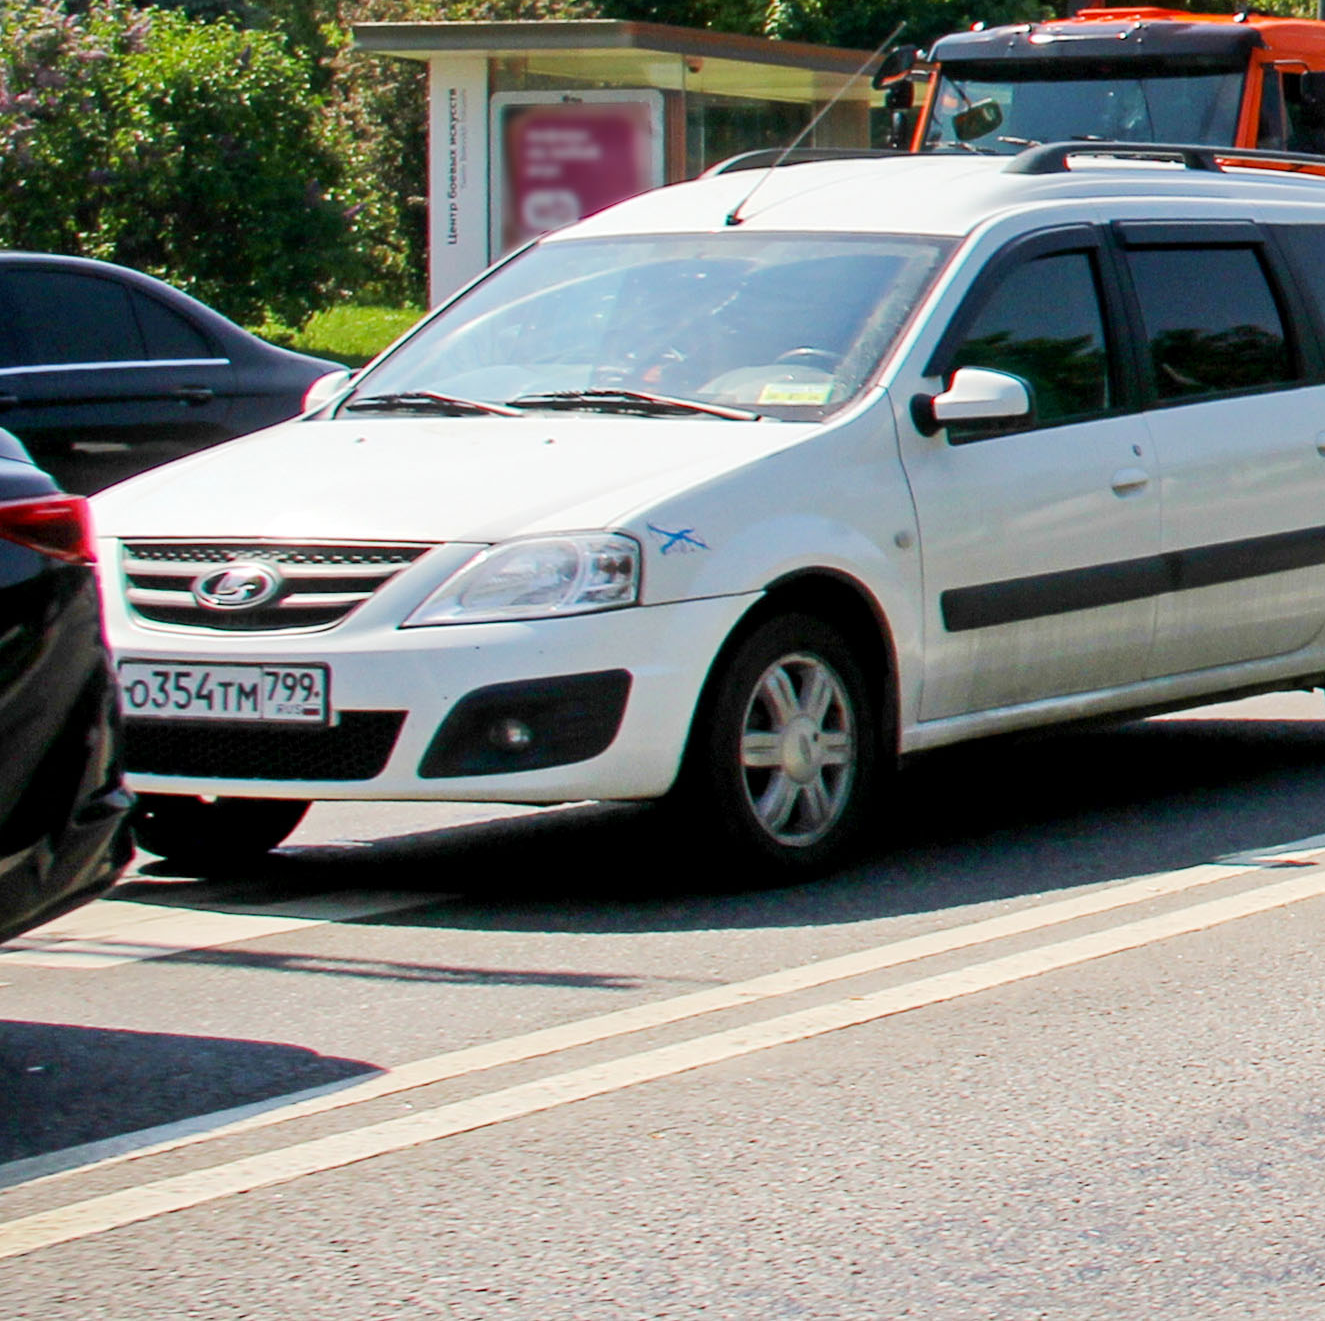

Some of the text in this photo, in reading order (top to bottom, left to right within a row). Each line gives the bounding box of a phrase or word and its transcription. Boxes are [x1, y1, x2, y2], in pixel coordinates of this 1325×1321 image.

[447, 87, 460, 246] Центр боевых искусств
[264, 670, 315, 702] 799
